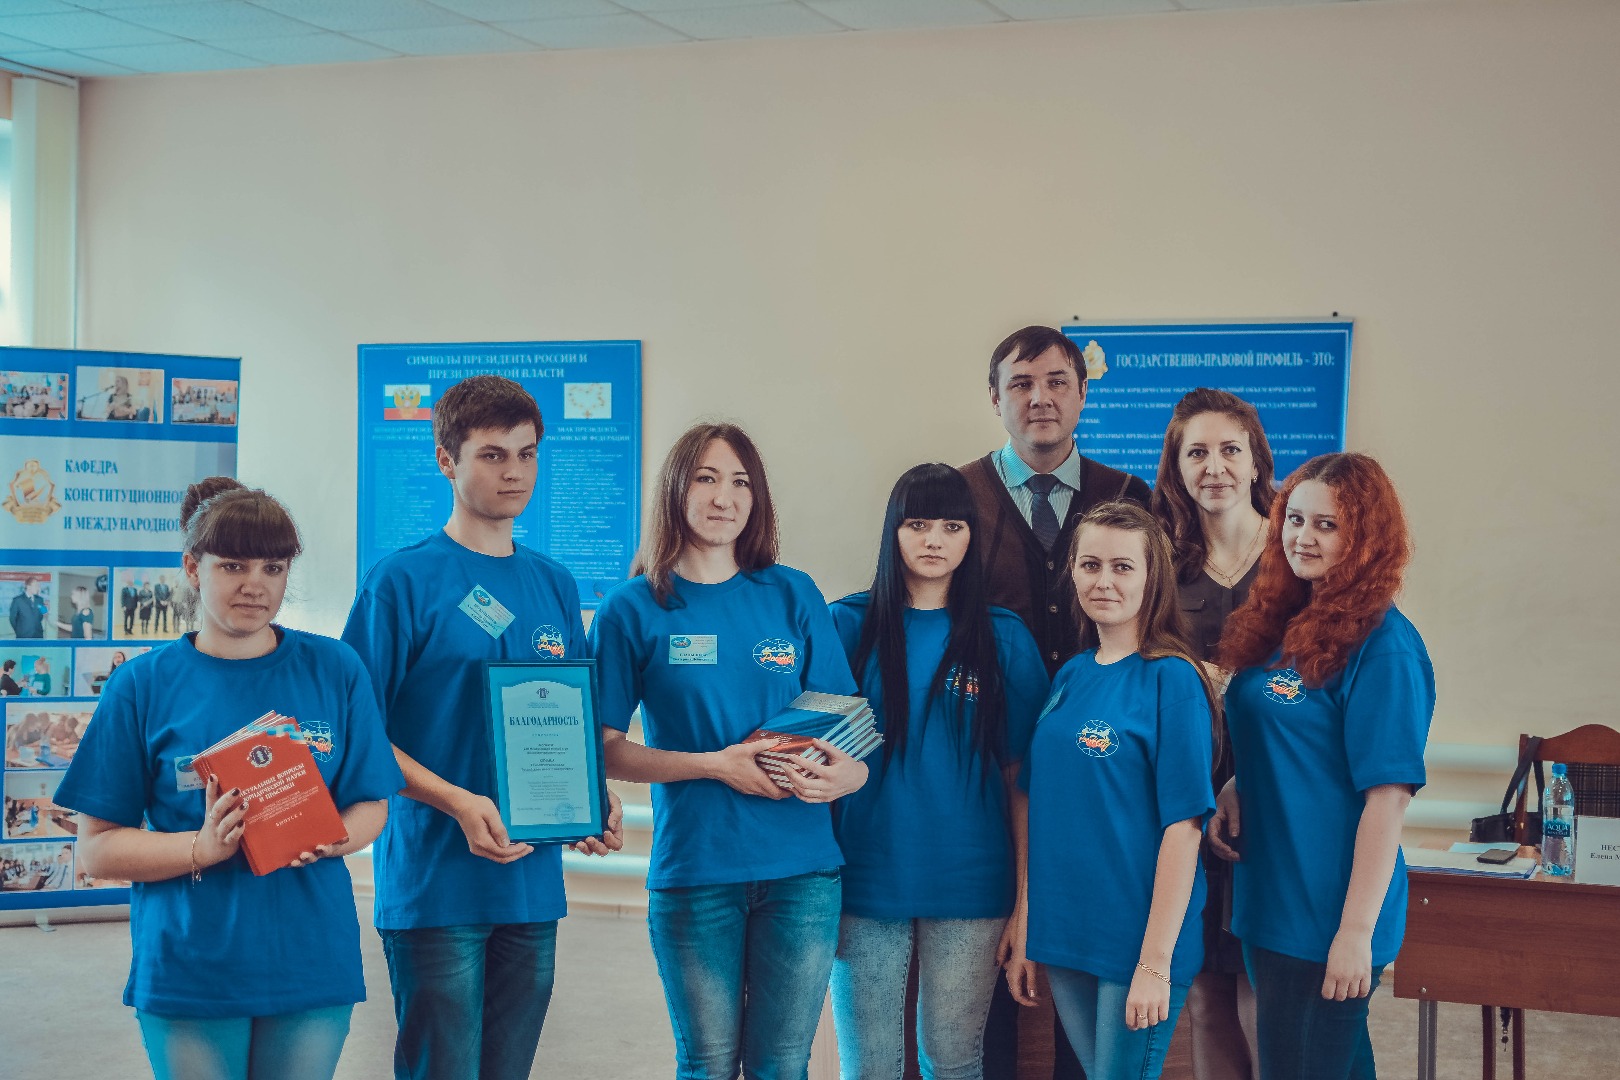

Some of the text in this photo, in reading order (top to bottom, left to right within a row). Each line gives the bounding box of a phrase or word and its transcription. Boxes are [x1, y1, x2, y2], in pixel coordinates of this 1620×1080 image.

[406, 353, 588, 366] СИМВОЛЫ ПРЕЗИДЕНТА РОССИИ И
[1116, 350, 1254, 368] ГОСУДАРСТВЕННО-ПРАВОВОЙ
[1256, 351, 1303, 367] ПРОФИЛЬ
[1312, 351, 1335, 367] ЭТО:
[521, 368, 565, 378] ВЛАСТИ
[65, 459, 119, 475] КАФЕДРА
[64, 516, 72, 530] И
[509, 715, 580, 728] БЛАГОДАРНОСТЬ
[276, 762, 305, 780] ВОПРОСЫ
[285, 769, 307, 782] НАУКИ
[265, 782, 296, 800] ПРАКТИКИ
[1547, 824, 1569, 832] AQUA
[1590, 852, 1613, 860] Елена
